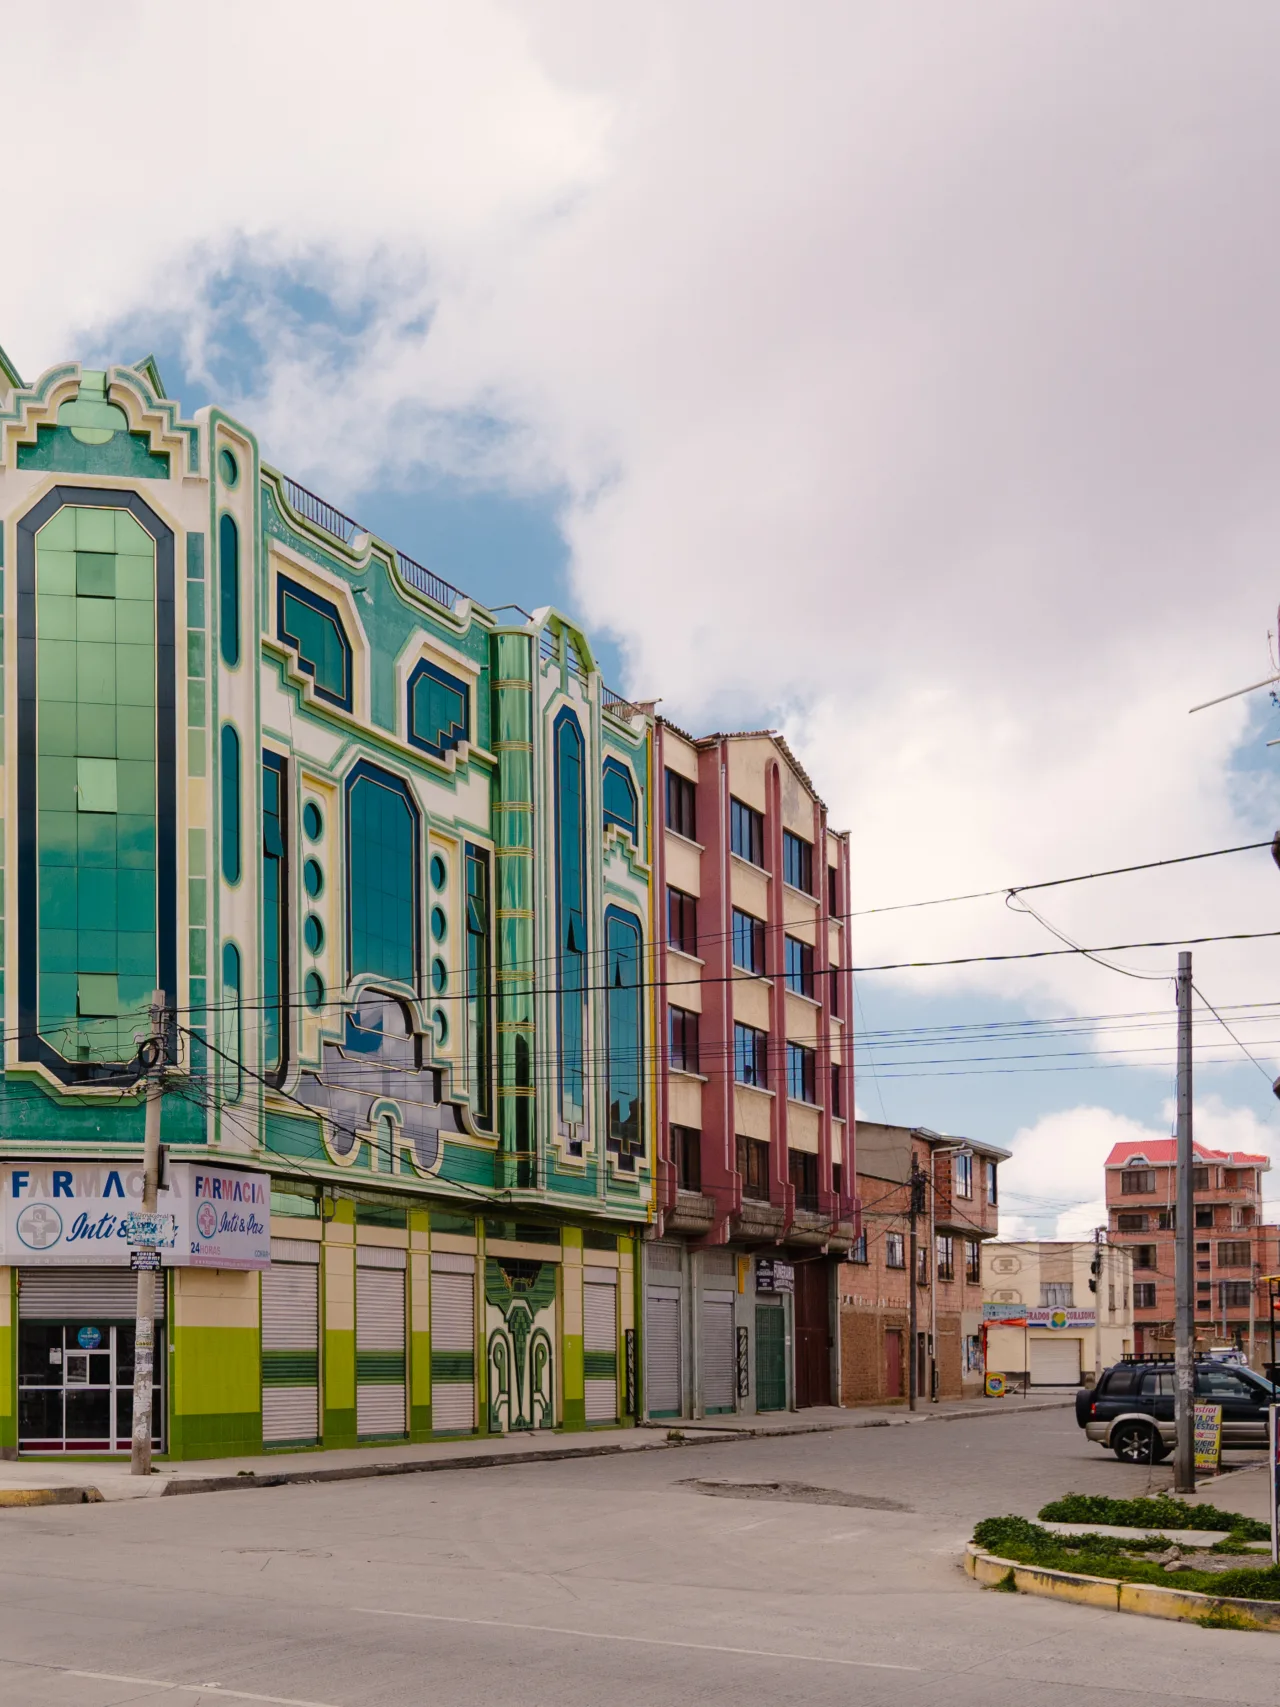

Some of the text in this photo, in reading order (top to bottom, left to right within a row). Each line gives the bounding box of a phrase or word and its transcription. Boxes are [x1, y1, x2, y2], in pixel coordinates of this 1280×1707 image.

[12, 1171, 182, 1198] FARMACA
[195, 1176, 265, 1204] FARMACIA
[66, 1212, 117, 1242] Inti
[218, 1211, 264, 1235] Inti & Paz
[1194, 1406, 1217, 1414] astrol
